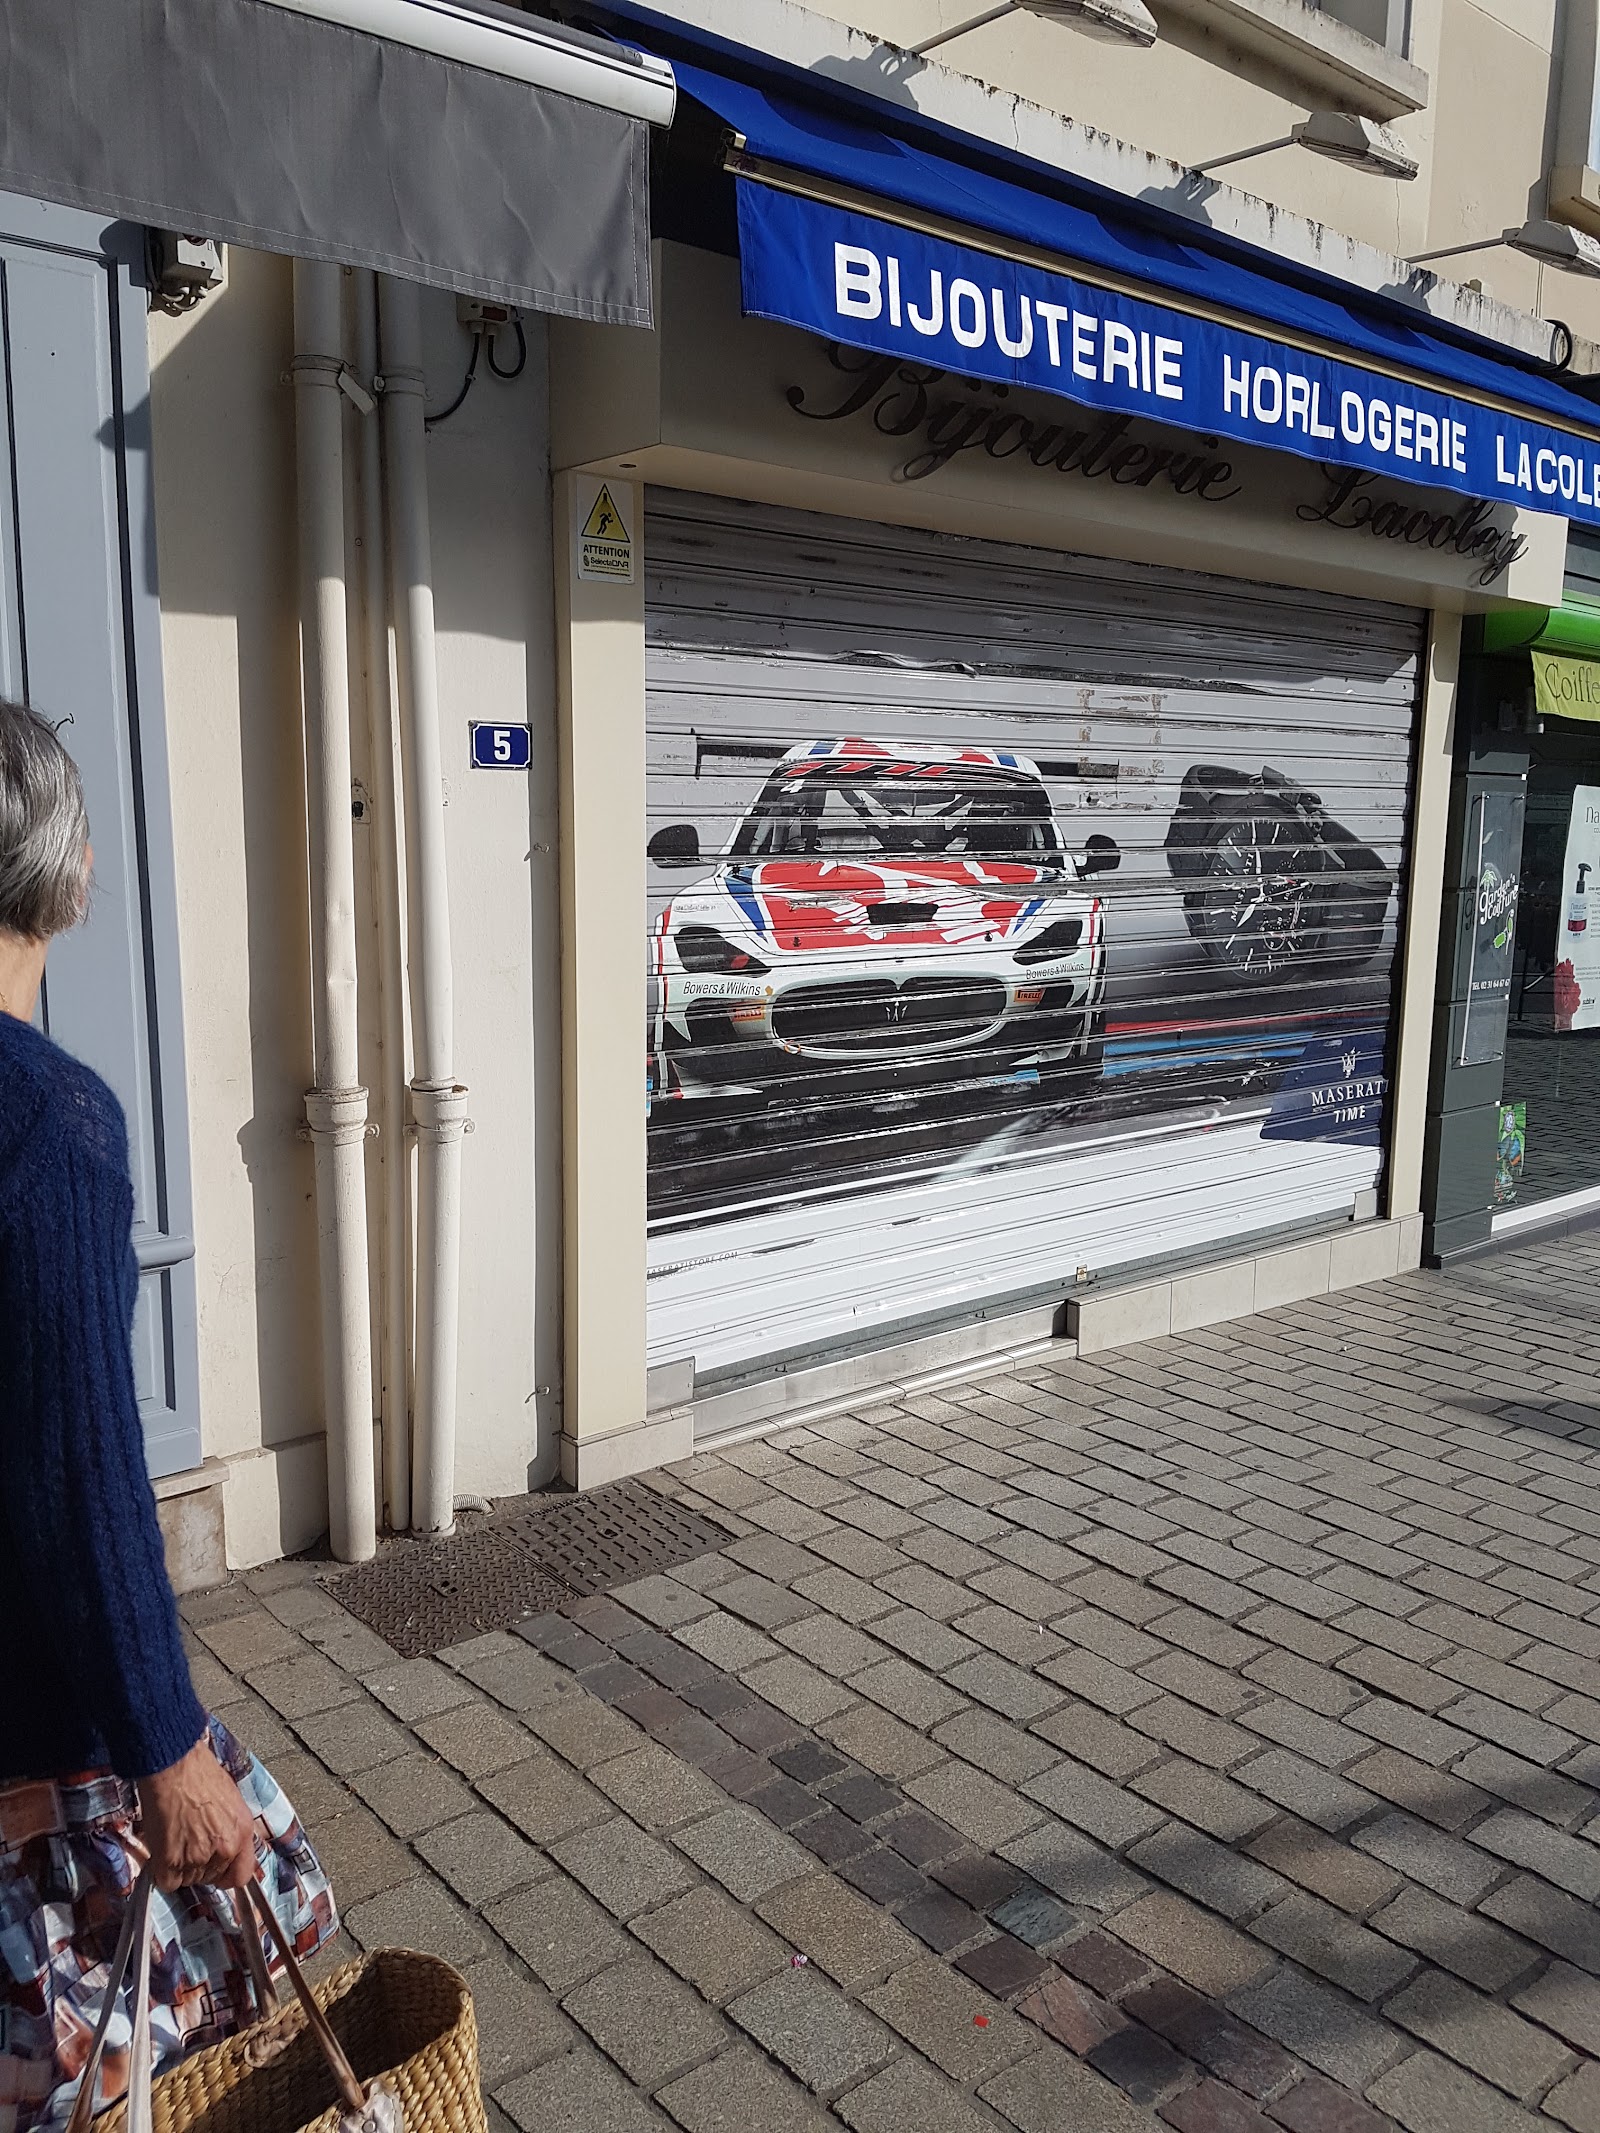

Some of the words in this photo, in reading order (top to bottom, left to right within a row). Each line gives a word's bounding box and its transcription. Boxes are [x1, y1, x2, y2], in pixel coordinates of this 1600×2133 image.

[834, 242, 1183, 401] BIJOUTERIE
[1223, 354, 1467, 474] HORLOGERIE
[786, 341, 1241, 501] Bijouterie
[1296, 462, 1529, 586] Lacoley
[583, 544, 630, 559] ATTENTION
[1545, 662, 1600, 704] Coiffe
[494, 730, 511, 761] 5
[1333, 1105, 1366, 1123] TIME
